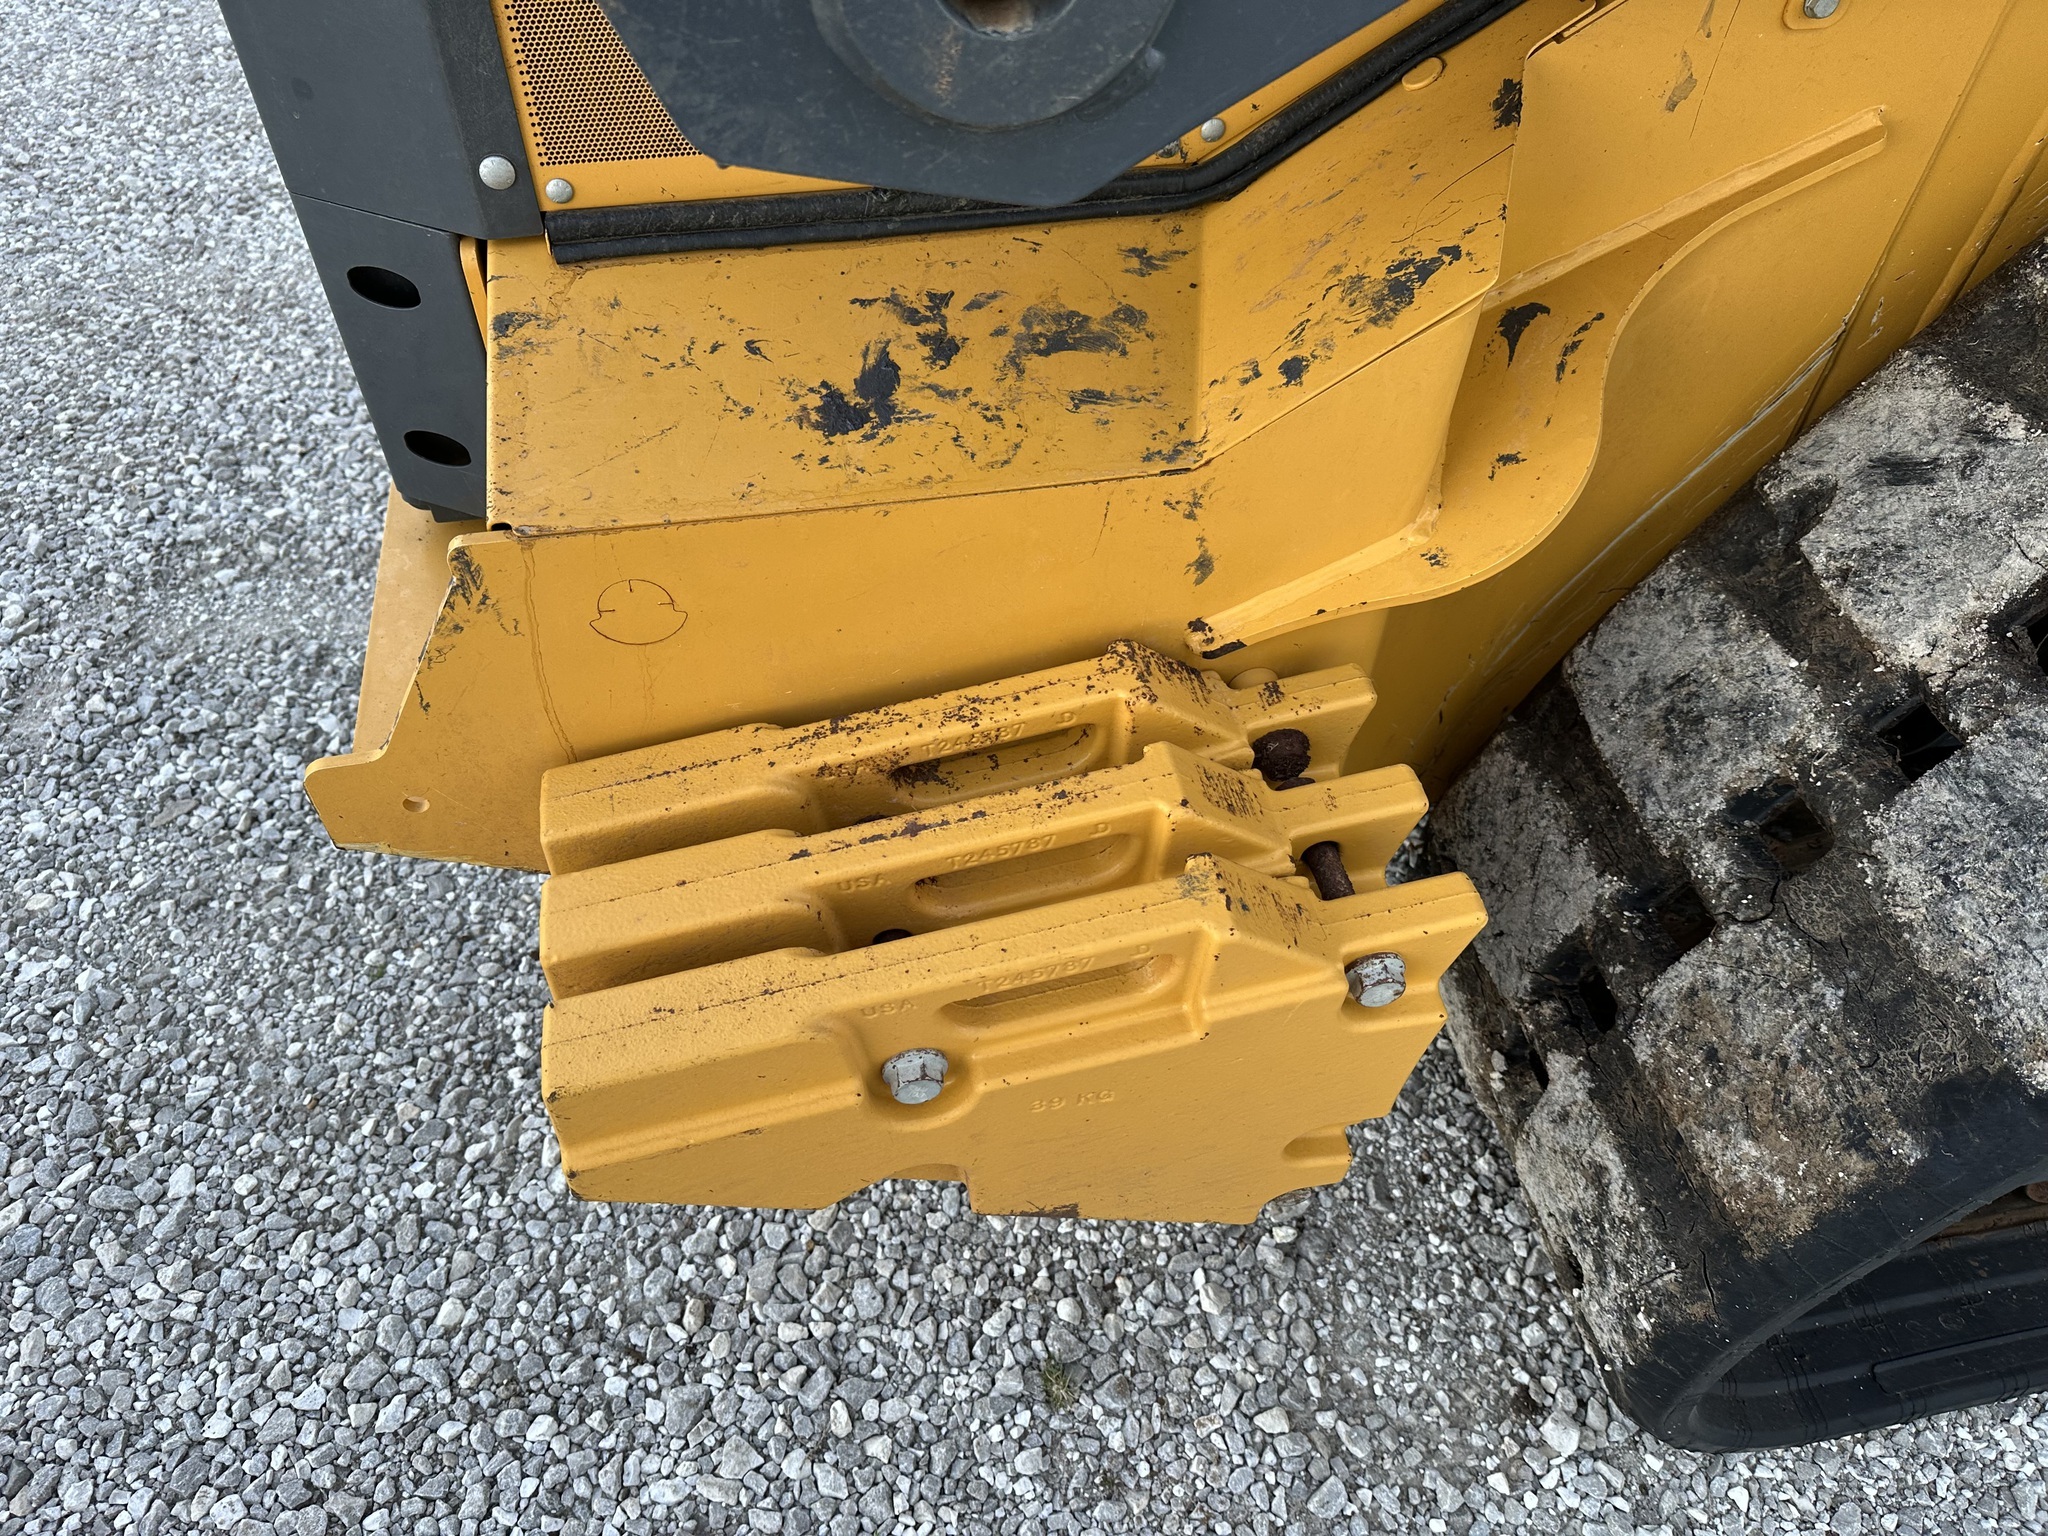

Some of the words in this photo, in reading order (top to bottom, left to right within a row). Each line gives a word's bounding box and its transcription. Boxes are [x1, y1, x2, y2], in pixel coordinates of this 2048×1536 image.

[946, 833, 1057, 869] T245787
[837, 873, 892, 894] USA
[976, 957, 1096, 993] T245787
[859, 998, 918, 1020] USA
[1076, 1088, 1116, 1107] KG
